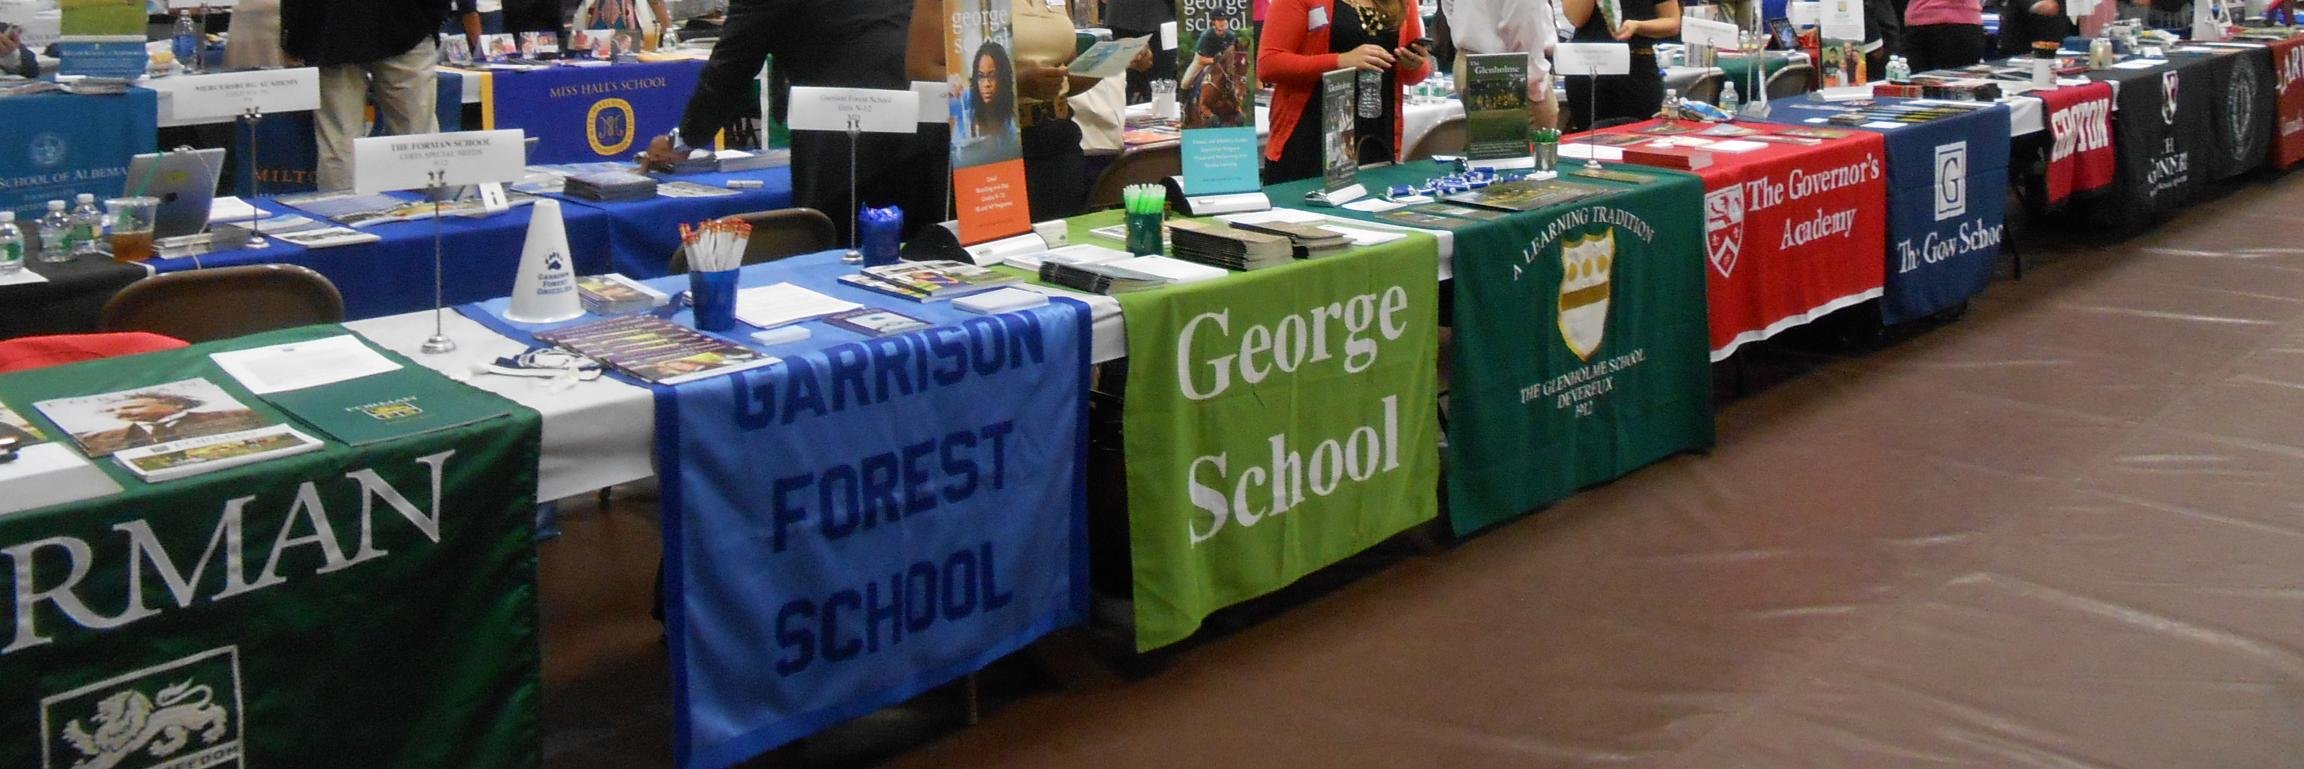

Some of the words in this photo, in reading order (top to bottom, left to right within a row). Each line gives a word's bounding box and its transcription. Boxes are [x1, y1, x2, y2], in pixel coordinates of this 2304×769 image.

[952, 11, 1009, 34] george
[1185, 12, 1247, 31] schol
[549, 86, 577, 97] MISS
[621, 77, 667, 90] SCHOOL
[391, 143, 408, 152] THE
[412, 140, 451, 150] FORMAN
[454, 138, 490, 147] SCHOOL
[1746, 176, 1784, 212] The
[1789, 153, 1880, 200] Governor's
[1942, 157, 1959, 203] G
[1513, 264, 1522, 280] A
[1523, 207, 1588, 263] LEARNING
[1593, 206, 1655, 244] TRADITION
[1780, 208, 1857, 250] Academy
[729, 309, 1044, 431] GARRISON
[1177, 285, 1408, 401] George
[1520, 383, 1541, 404] THE
[1543, 361, 1608, 396] GLENHOLME
[1609, 348, 1647, 373] SCHOOL
[1557, 376, 1614, 409] DEVEREUX
[772, 420, 1013, 554] FOREST
[1188, 394, 1399, 550] School
[0, 449, 456, 655] RMAN
[775, 541, 1013, 677] SCHOOL
